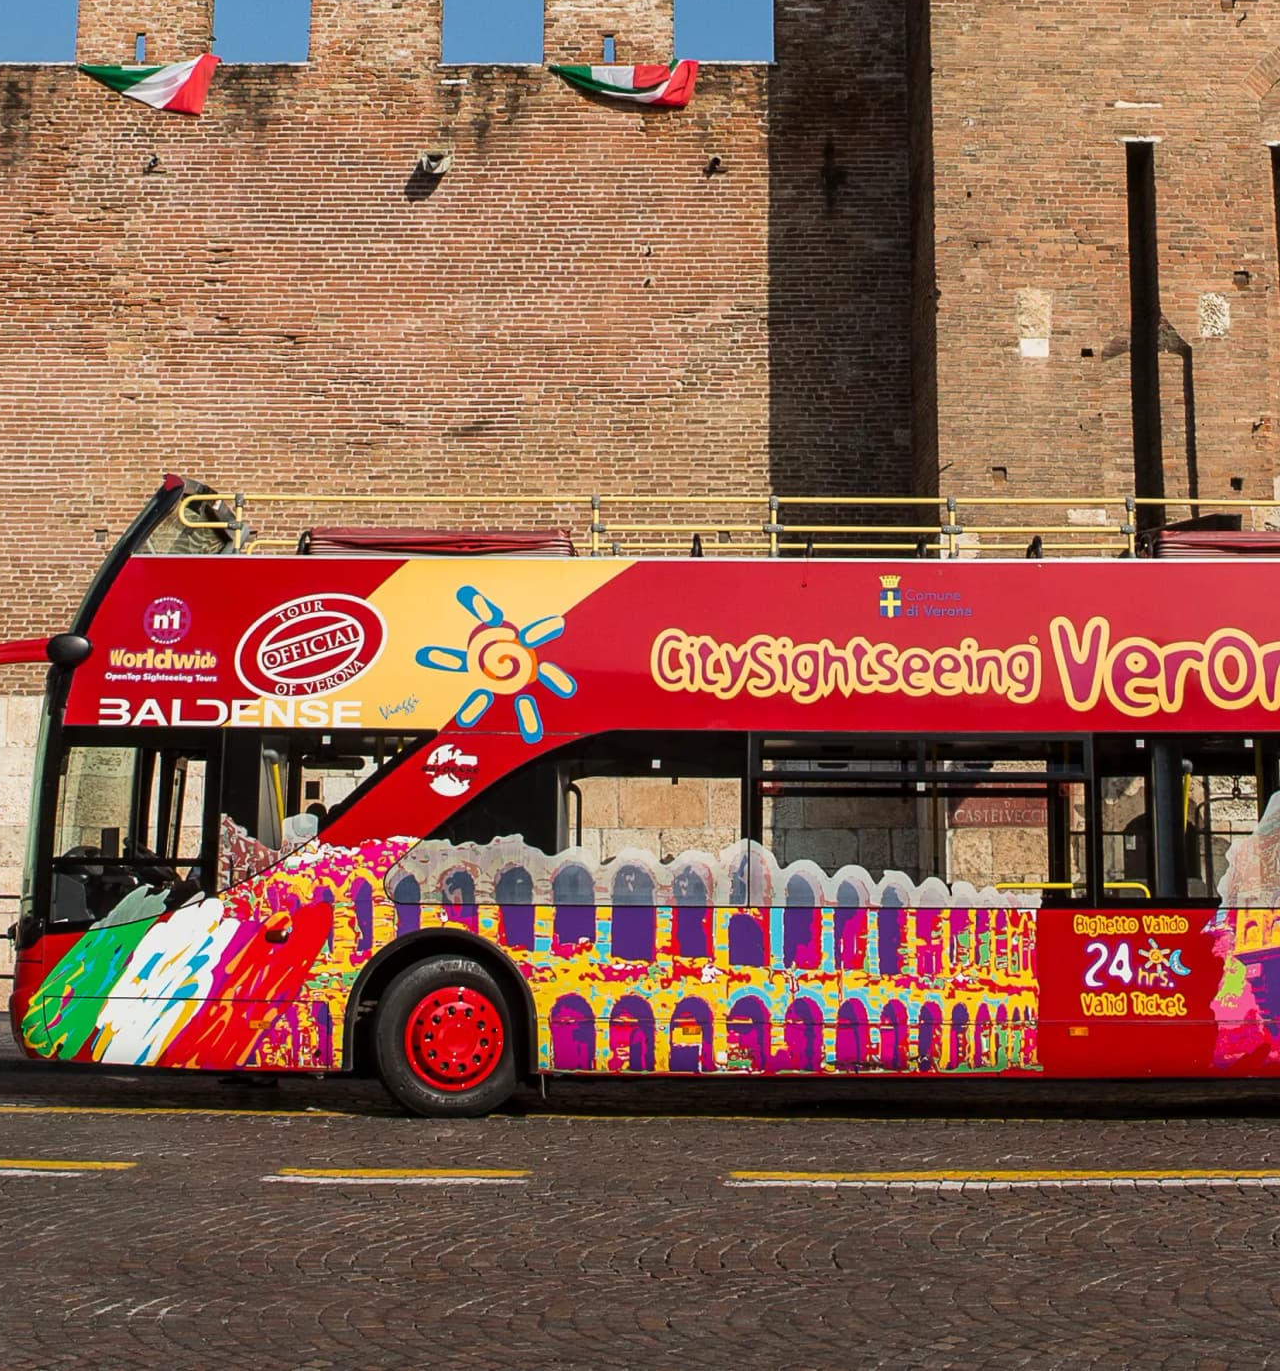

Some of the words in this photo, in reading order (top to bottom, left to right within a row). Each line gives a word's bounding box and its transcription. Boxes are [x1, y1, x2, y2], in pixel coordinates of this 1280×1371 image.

[905, 589, 962, 601] Comune
[275, 600, 325, 623] TOUR
[906, 605, 918, 617] di
[923, 606, 973, 617] Verona
[109, 648, 217, 669] Worldwide
[263, 625, 360, 669] OFFICIAL
[105, 672, 141, 682] OpenTop
[142, 673, 193, 683] Sightseeing
[195, 674, 218, 682] Tours
[274, 683, 297, 696] OF
[302, 659, 366, 695] VERONA
[98, 698, 363, 728] BALDENSE
[1074, 914, 1139, 937] Biglietto
[1142, 915, 1189, 934] Valido
[1085, 942, 1133, 987] 24
[1081, 992, 1127, 1016] Valid
[1130, 991, 1188, 1017] Ticket
